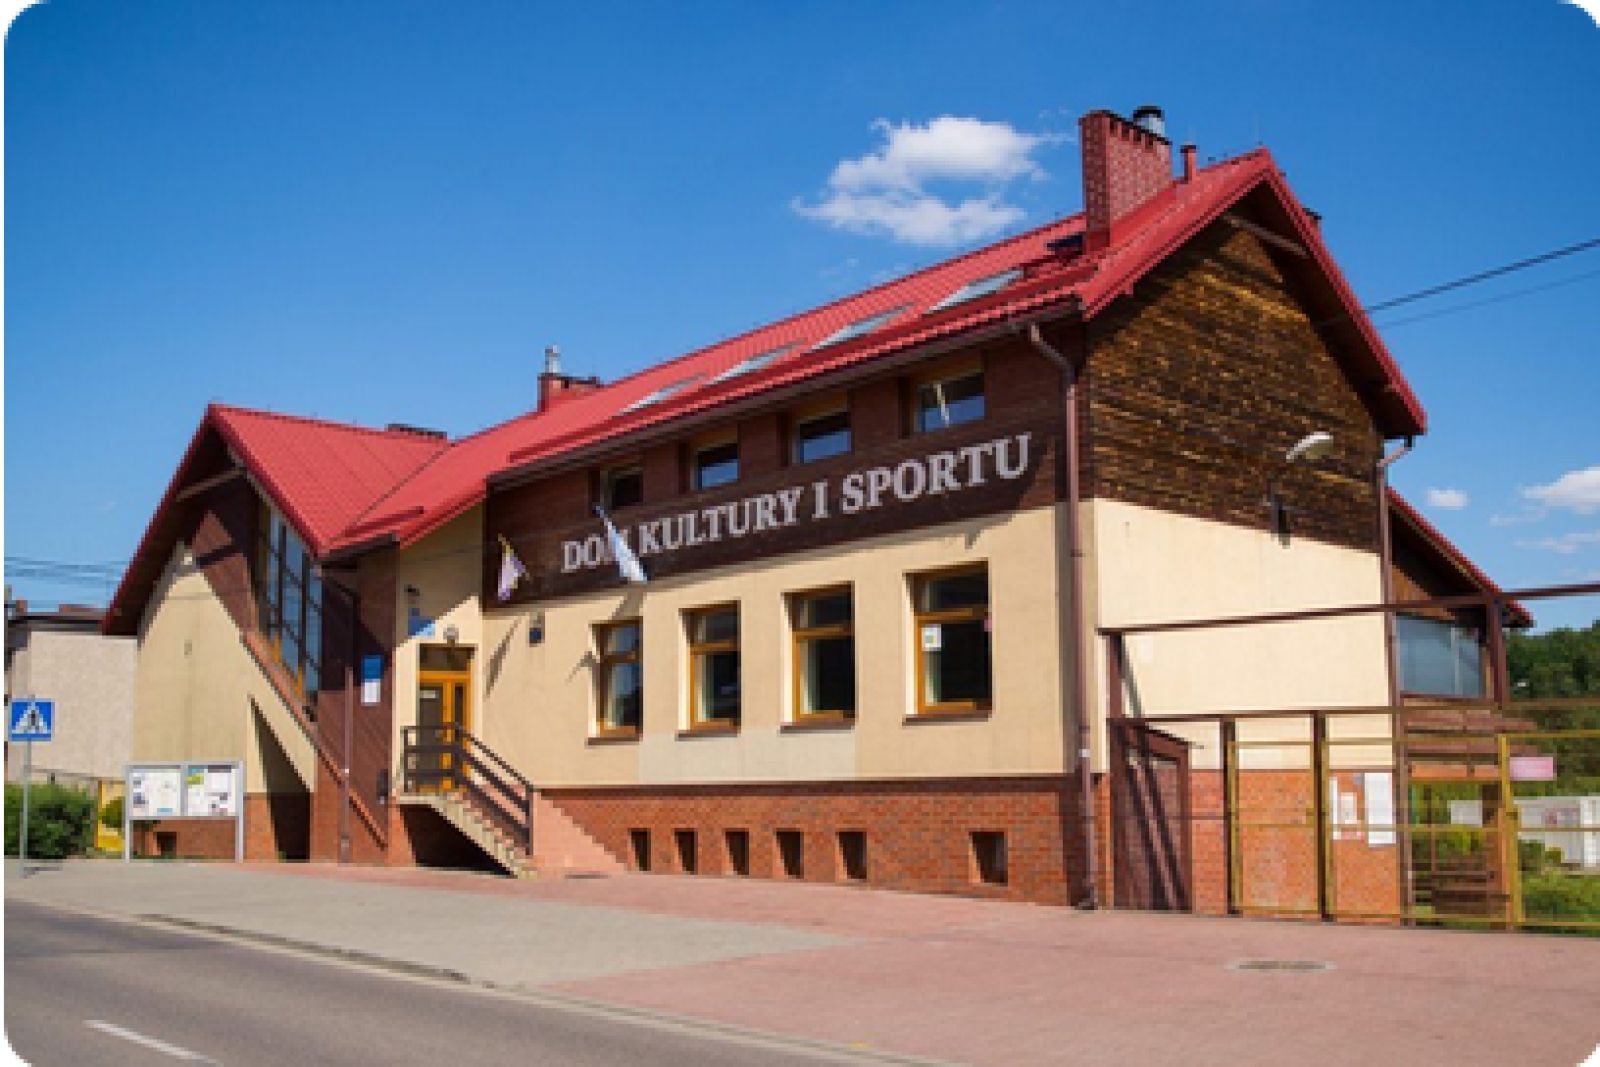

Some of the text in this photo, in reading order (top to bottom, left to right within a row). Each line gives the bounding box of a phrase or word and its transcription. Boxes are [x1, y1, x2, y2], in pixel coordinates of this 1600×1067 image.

[638, 486, 803, 555] KULTURY
[813, 481, 830, 520] I
[842, 433, 1032, 513] SPORTU
